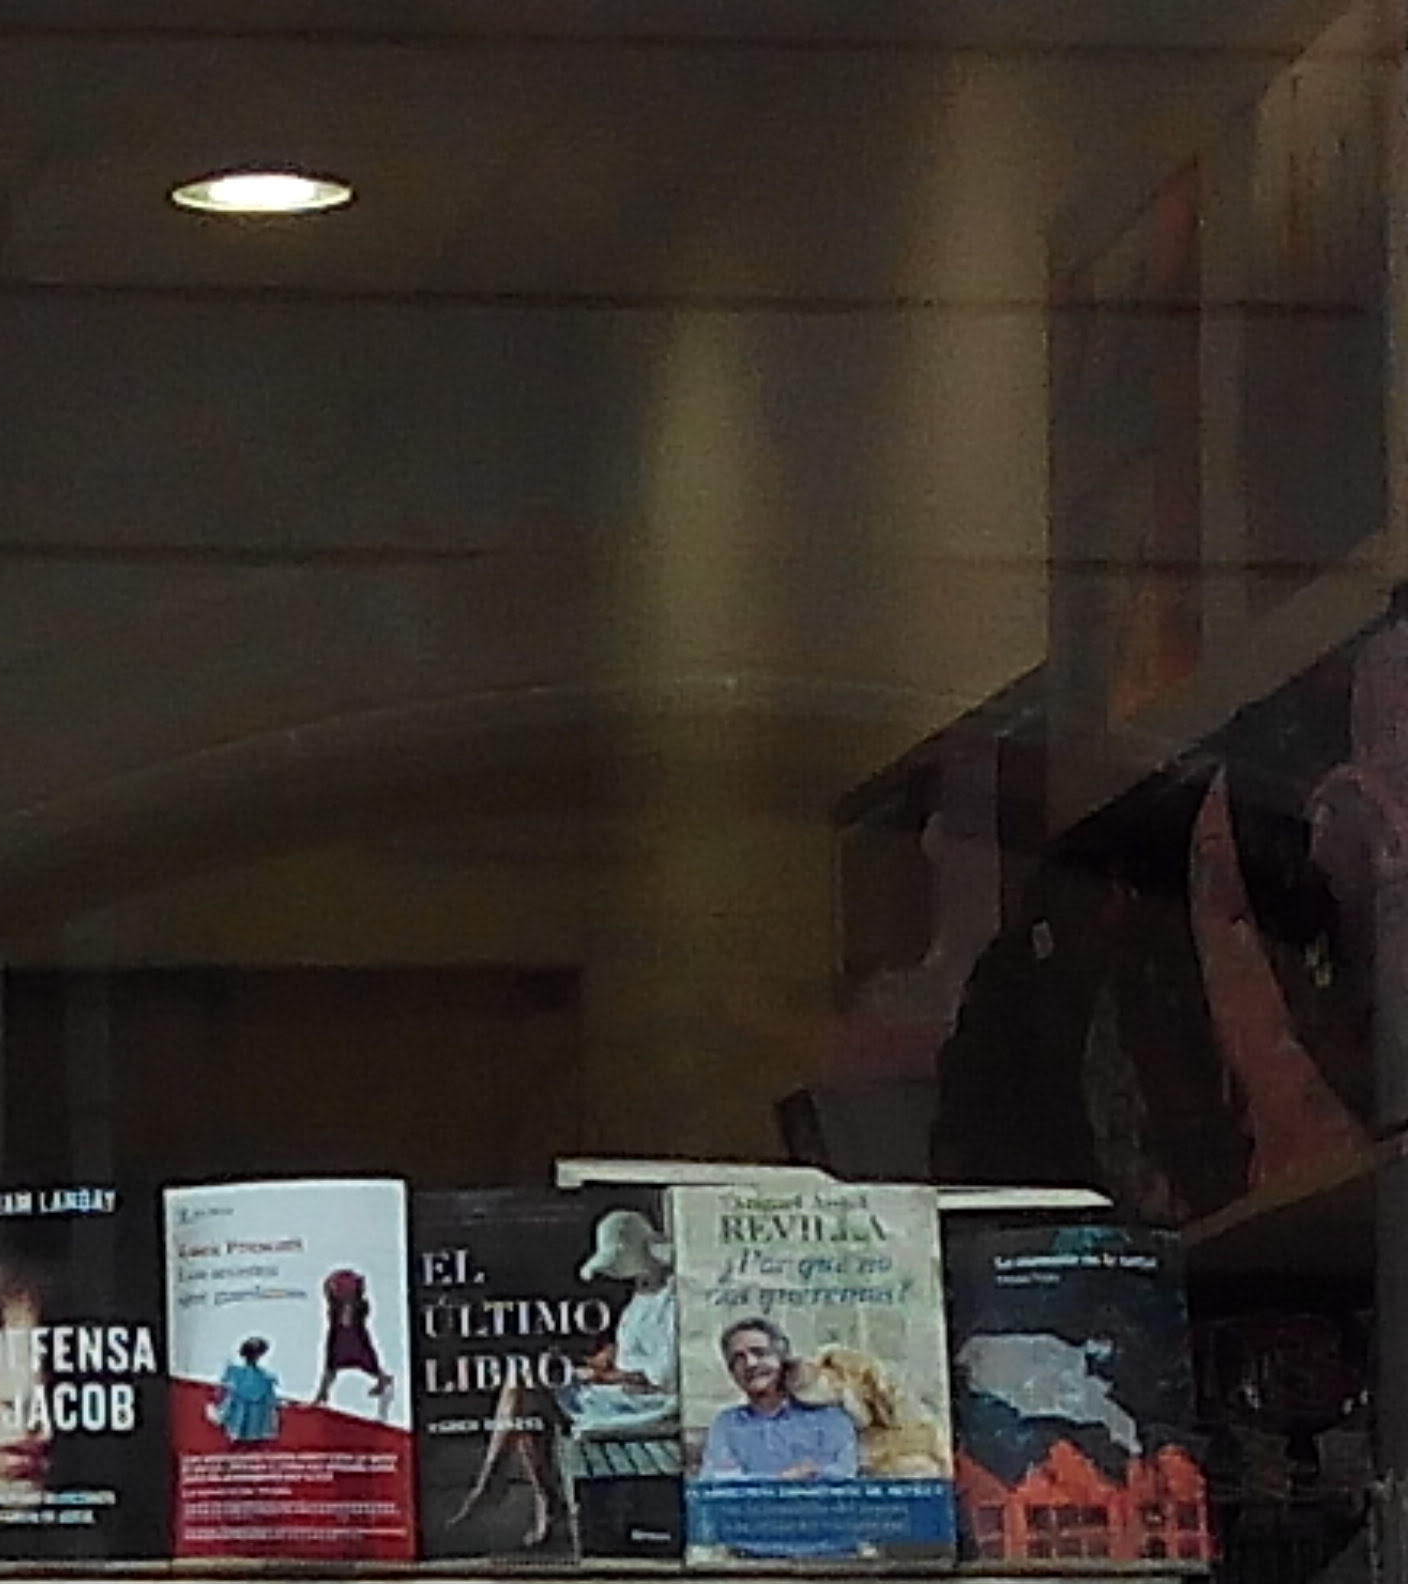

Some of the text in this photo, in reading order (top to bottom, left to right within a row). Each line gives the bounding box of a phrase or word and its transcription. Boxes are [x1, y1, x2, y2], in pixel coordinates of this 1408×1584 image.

[422, 1249, 486, 1287] EL
[422, 1292, 613, 1339] ÚLTIMO
[424, 1348, 575, 1394] LIBRO
[0, 1382, 137, 1433] JACOB
